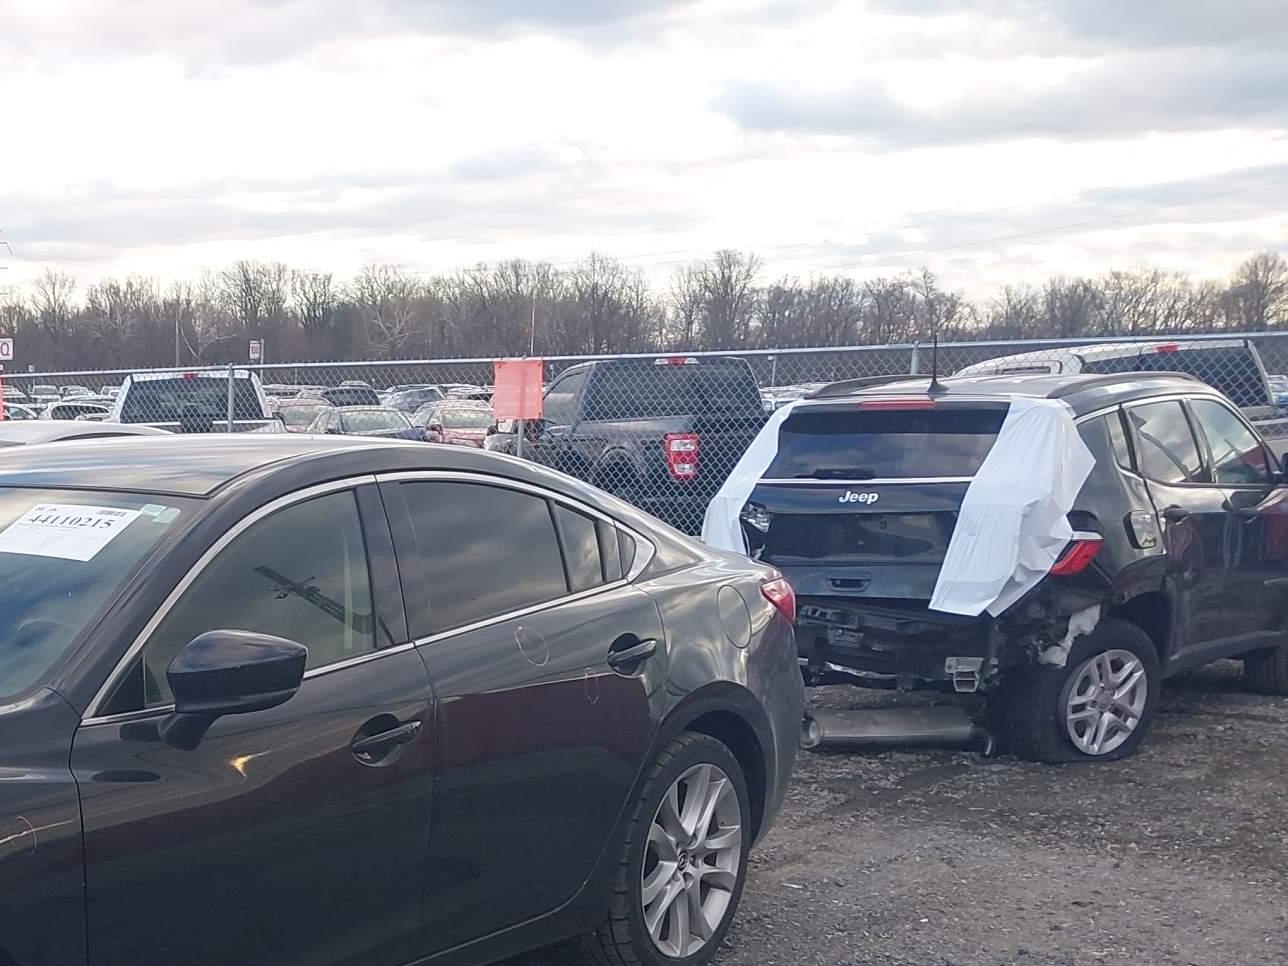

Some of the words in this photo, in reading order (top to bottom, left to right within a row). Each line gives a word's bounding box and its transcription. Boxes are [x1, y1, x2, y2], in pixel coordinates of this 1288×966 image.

[0, 342, 10, 356] Q
[838, 490, 879, 504] Jeep
[28, 513, 116, 529] 44110215
